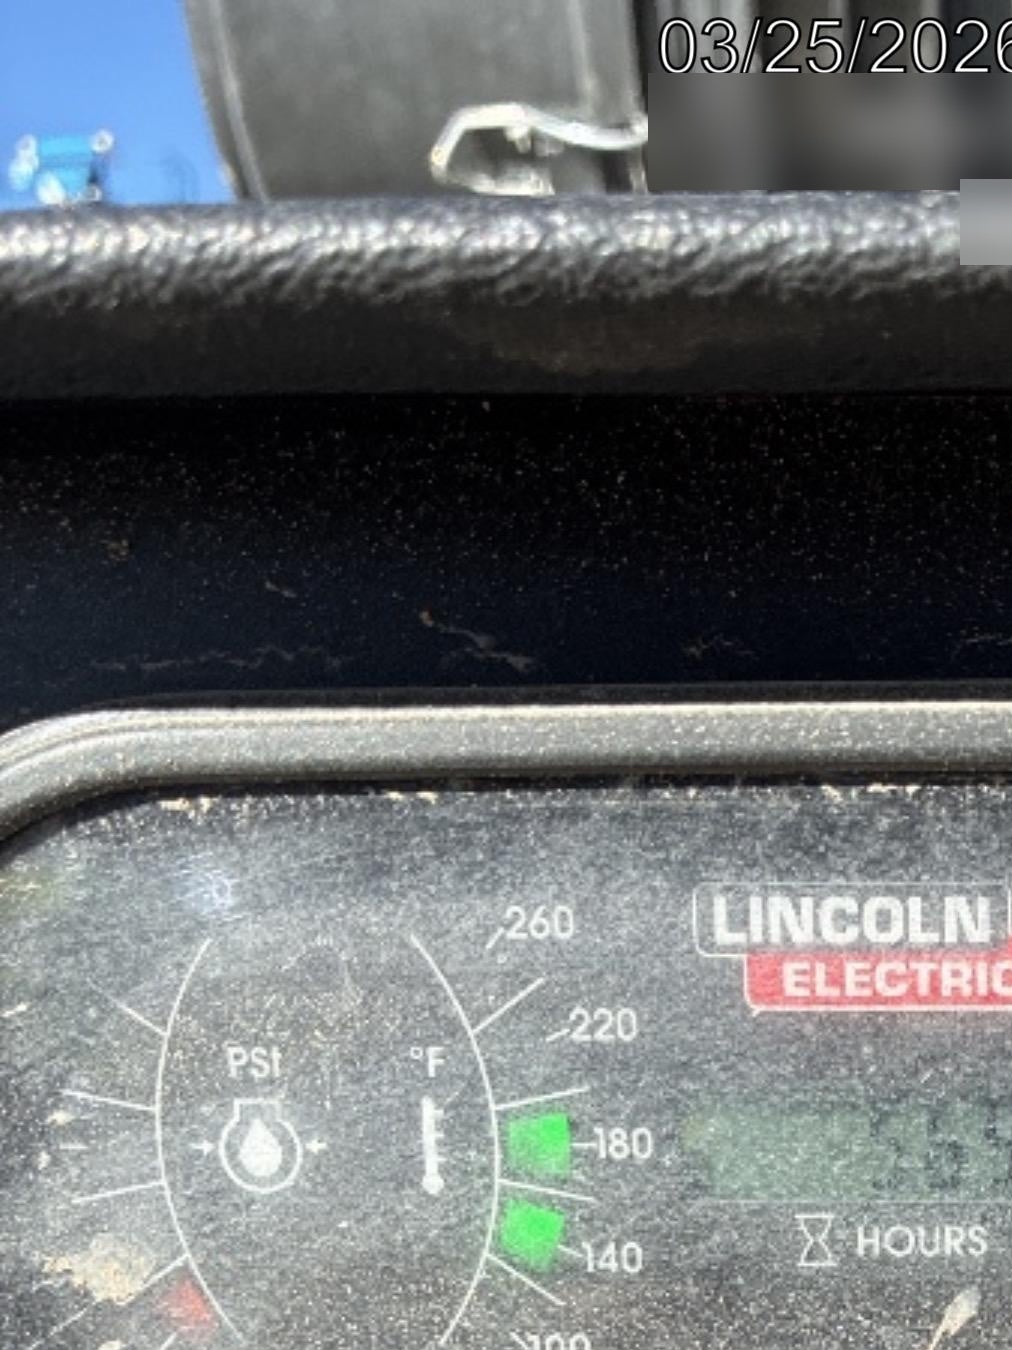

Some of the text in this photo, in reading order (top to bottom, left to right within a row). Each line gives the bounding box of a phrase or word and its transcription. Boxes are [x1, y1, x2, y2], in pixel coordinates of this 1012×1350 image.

[504, 906, 574, 940] 260
[713, 896, 992, 944] LINCOLN
[569, 1008, 637, 1042] 220
[228, 1047, 282, 1077] PSI
[594, 1128, 652, 1160] 180
[583, 1240, 643, 1274] 140
[856, 1225, 989, 1257] HOURS
